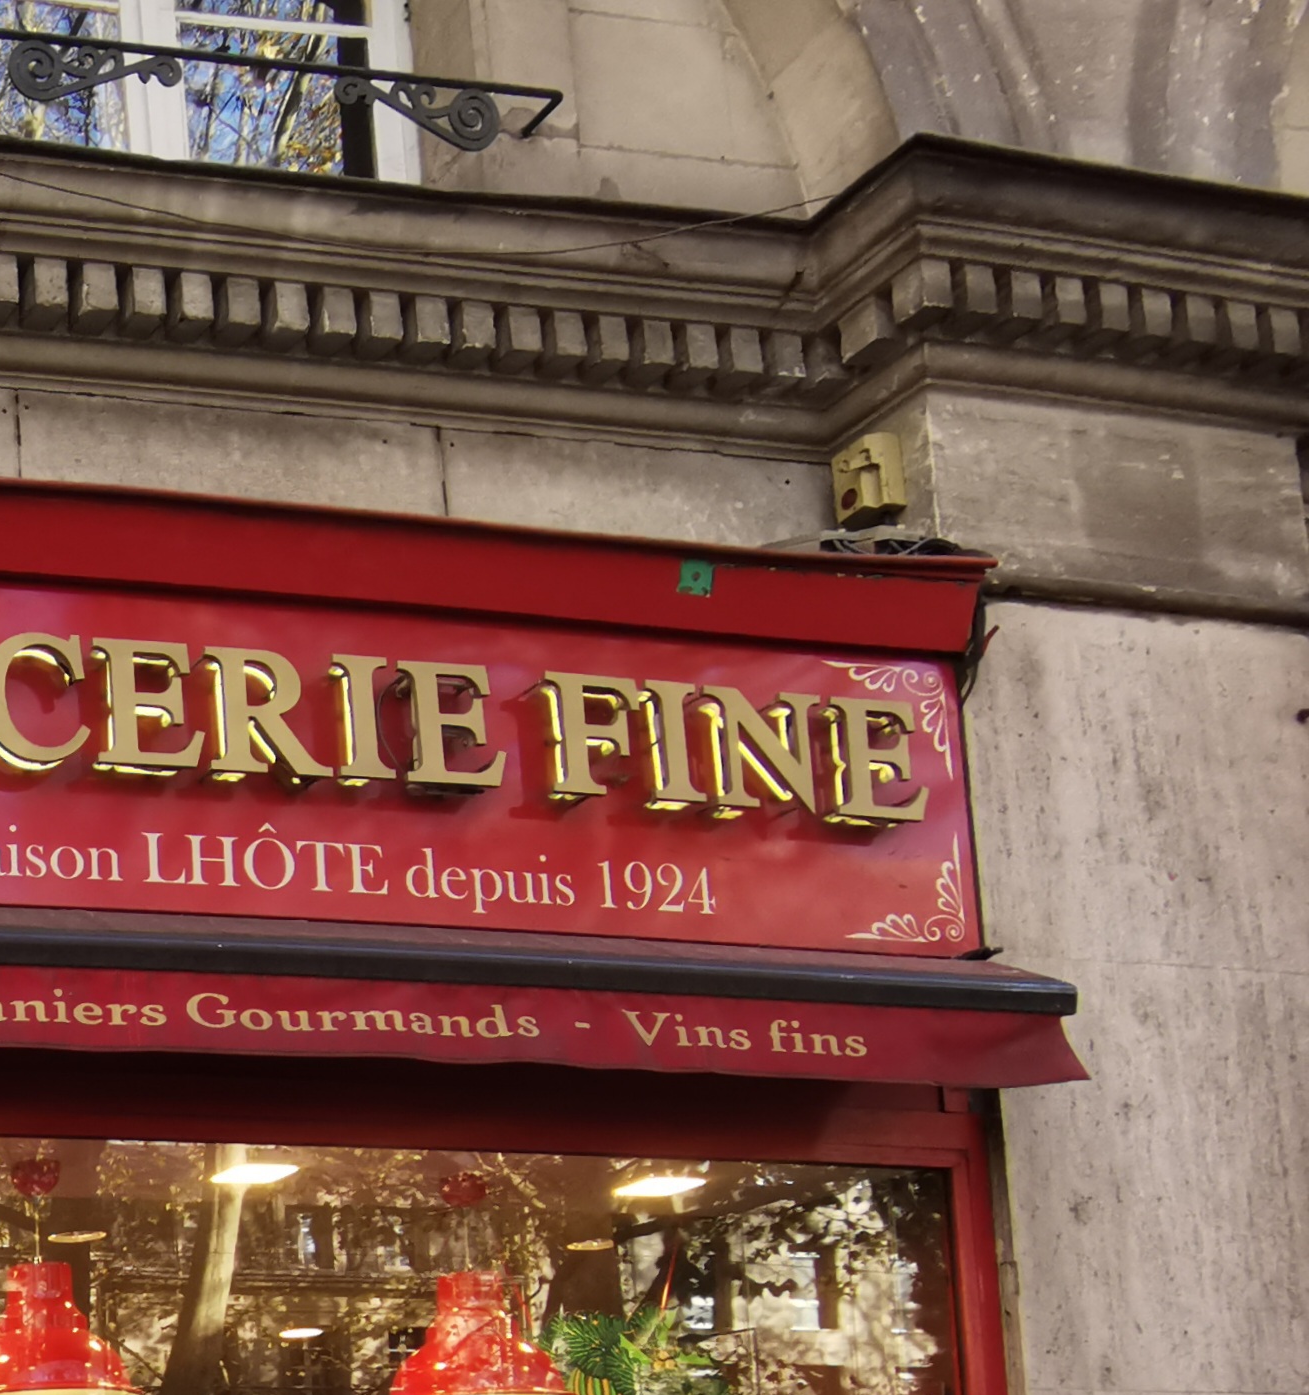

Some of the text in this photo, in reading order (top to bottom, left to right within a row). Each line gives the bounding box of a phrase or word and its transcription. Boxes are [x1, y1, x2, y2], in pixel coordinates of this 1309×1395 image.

[541, 670, 929, 828] FINE
[141, 822, 389, 897] LHÔTE
[405, 849, 575, 914] depuis
[597, 860, 717, 916] 1924
[186, 993, 540, 1039] Gourmands
[623, 1010, 752, 1052] Vins
[770, 1019, 868, 1059] fins
